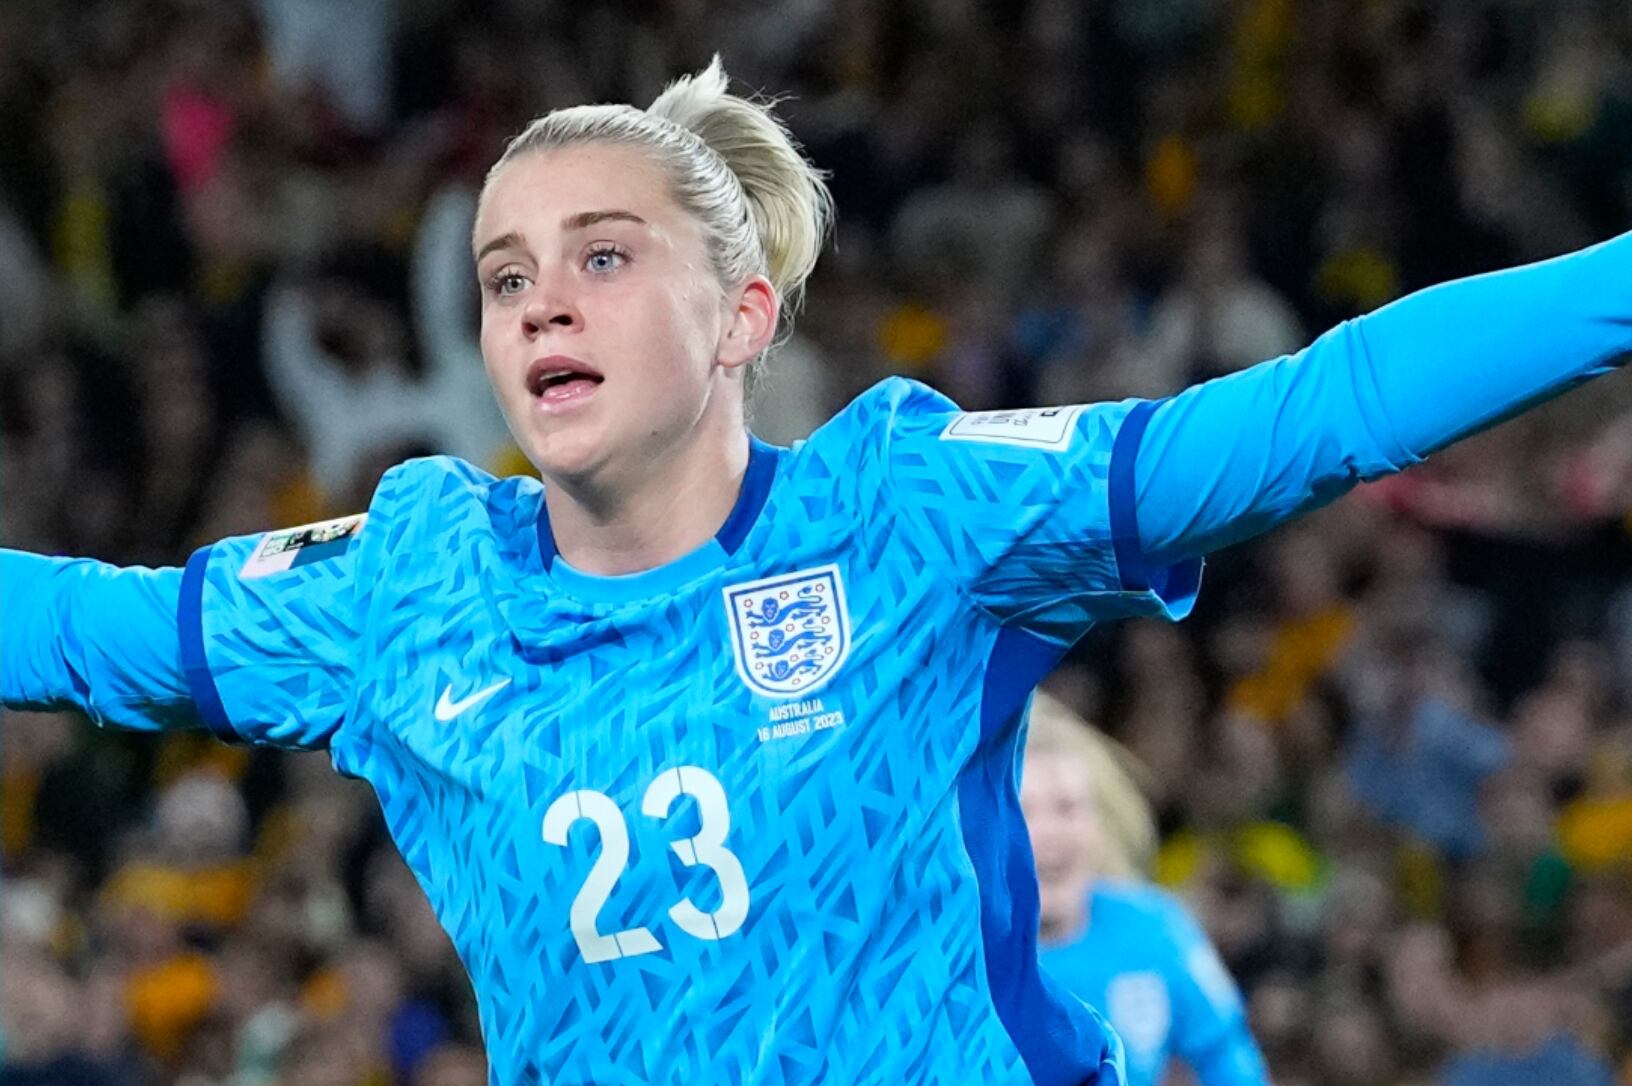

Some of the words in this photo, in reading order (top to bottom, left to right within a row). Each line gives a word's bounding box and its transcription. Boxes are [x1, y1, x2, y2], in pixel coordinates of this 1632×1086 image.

[770, 698, 824, 721] AUSTRALIA
[757, 727, 770, 742] 16
[773, 718, 810, 739] AUGUST
[814, 711, 844, 730] 2023
[542, 765, 751, 964] 23
